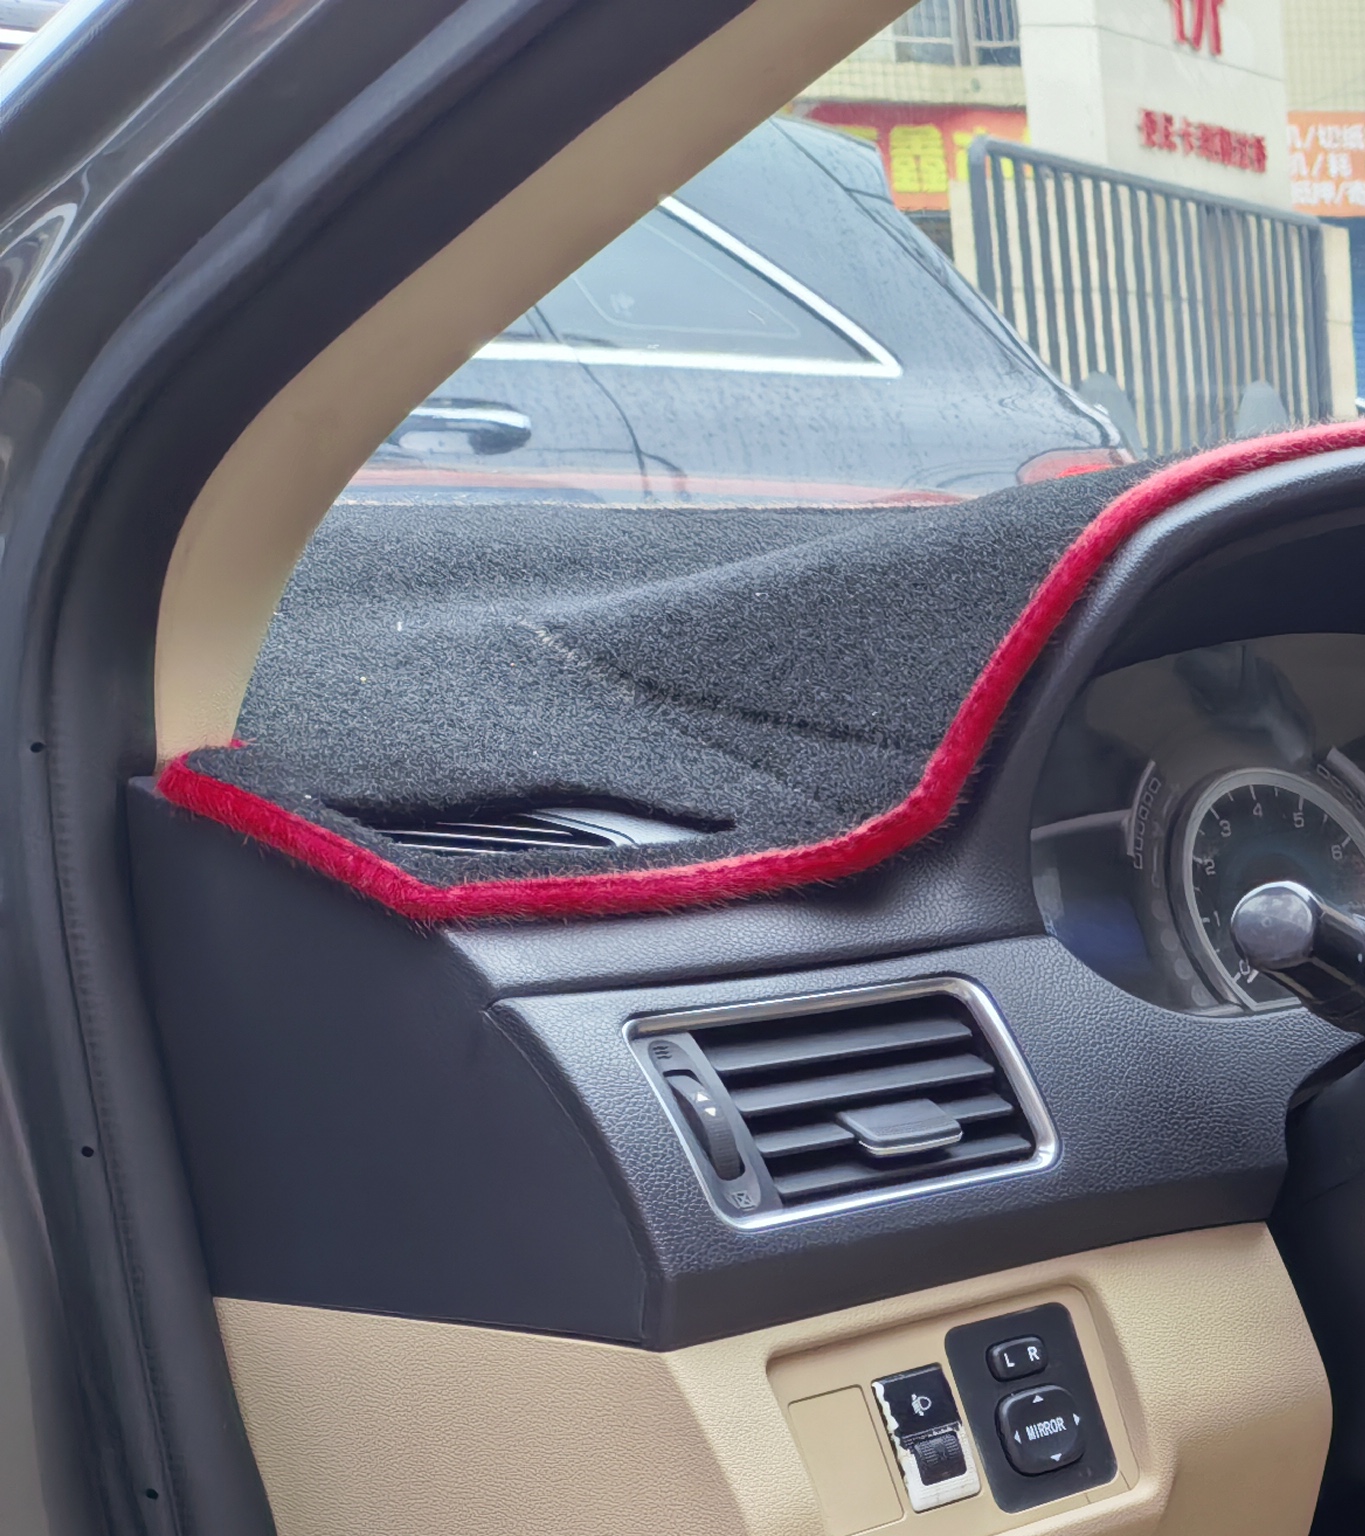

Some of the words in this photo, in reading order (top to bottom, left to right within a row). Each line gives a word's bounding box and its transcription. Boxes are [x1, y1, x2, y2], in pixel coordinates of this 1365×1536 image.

[1204, 858, 1216, 876] 2
[1219, 820, 1232, 838] 3
[1252, 803, 1263, 818] 4
[1293, 812, 1305, 828] 5
[1331, 844, 1343, 861] 6
[1003, 1352, 1015, 1368] L
[1027, 1345, 1041, 1362] R
[1025, 1416, 1067, 1442] MIRROR
